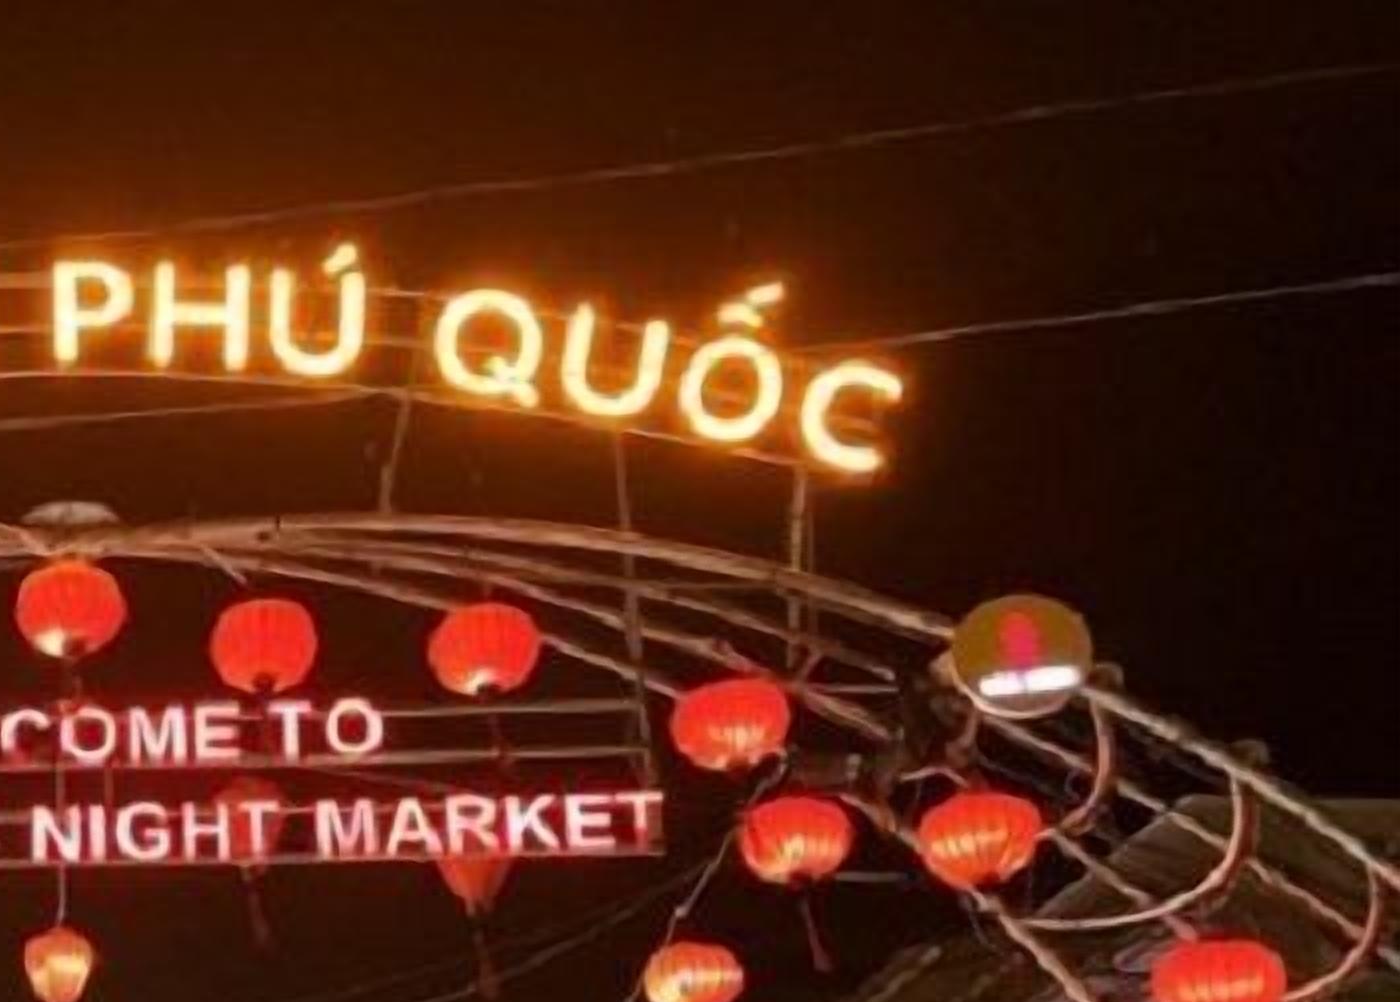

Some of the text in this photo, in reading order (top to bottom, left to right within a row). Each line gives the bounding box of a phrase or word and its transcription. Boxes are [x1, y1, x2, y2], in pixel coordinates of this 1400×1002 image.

[49, 243, 369, 377] PHÚ
[433, 282, 904, 473] QUỐC
[268, 697, 385, 758] TO
[30, 800, 282, 862] NIGHT
[314, 790, 664, 857] MARKET
